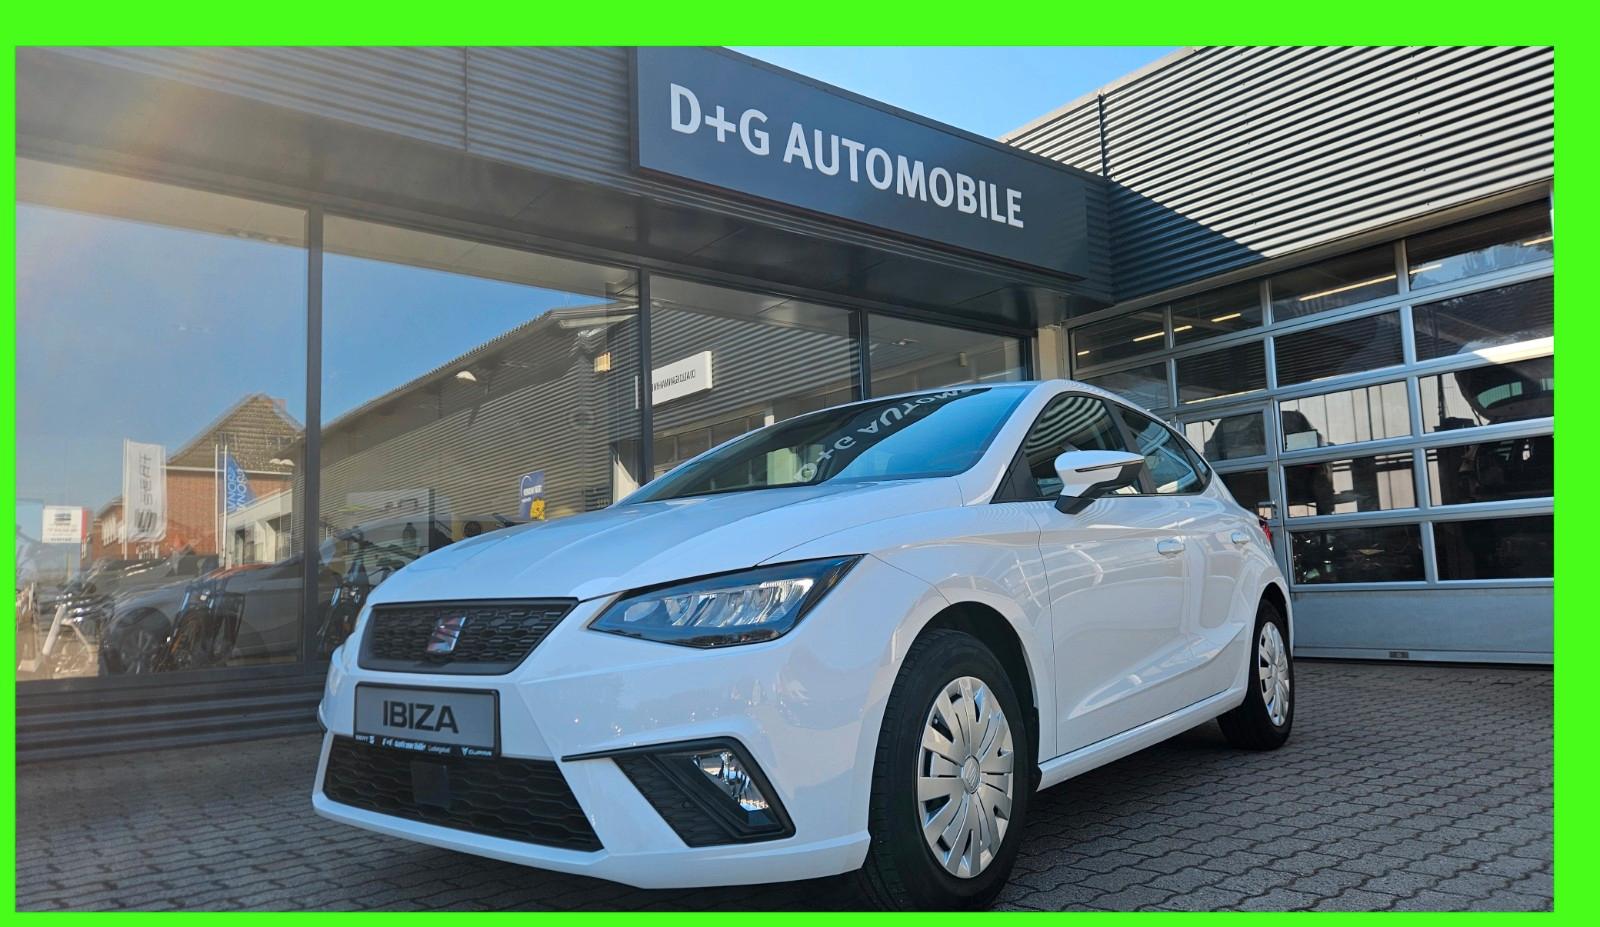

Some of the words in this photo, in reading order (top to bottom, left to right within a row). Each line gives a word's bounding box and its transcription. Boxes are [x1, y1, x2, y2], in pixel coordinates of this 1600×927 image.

[670, 83, 769, 155] D+G
[783, 122, 1024, 228] AUTOMOBILE
[383, 700, 459, 734] IBIZA
